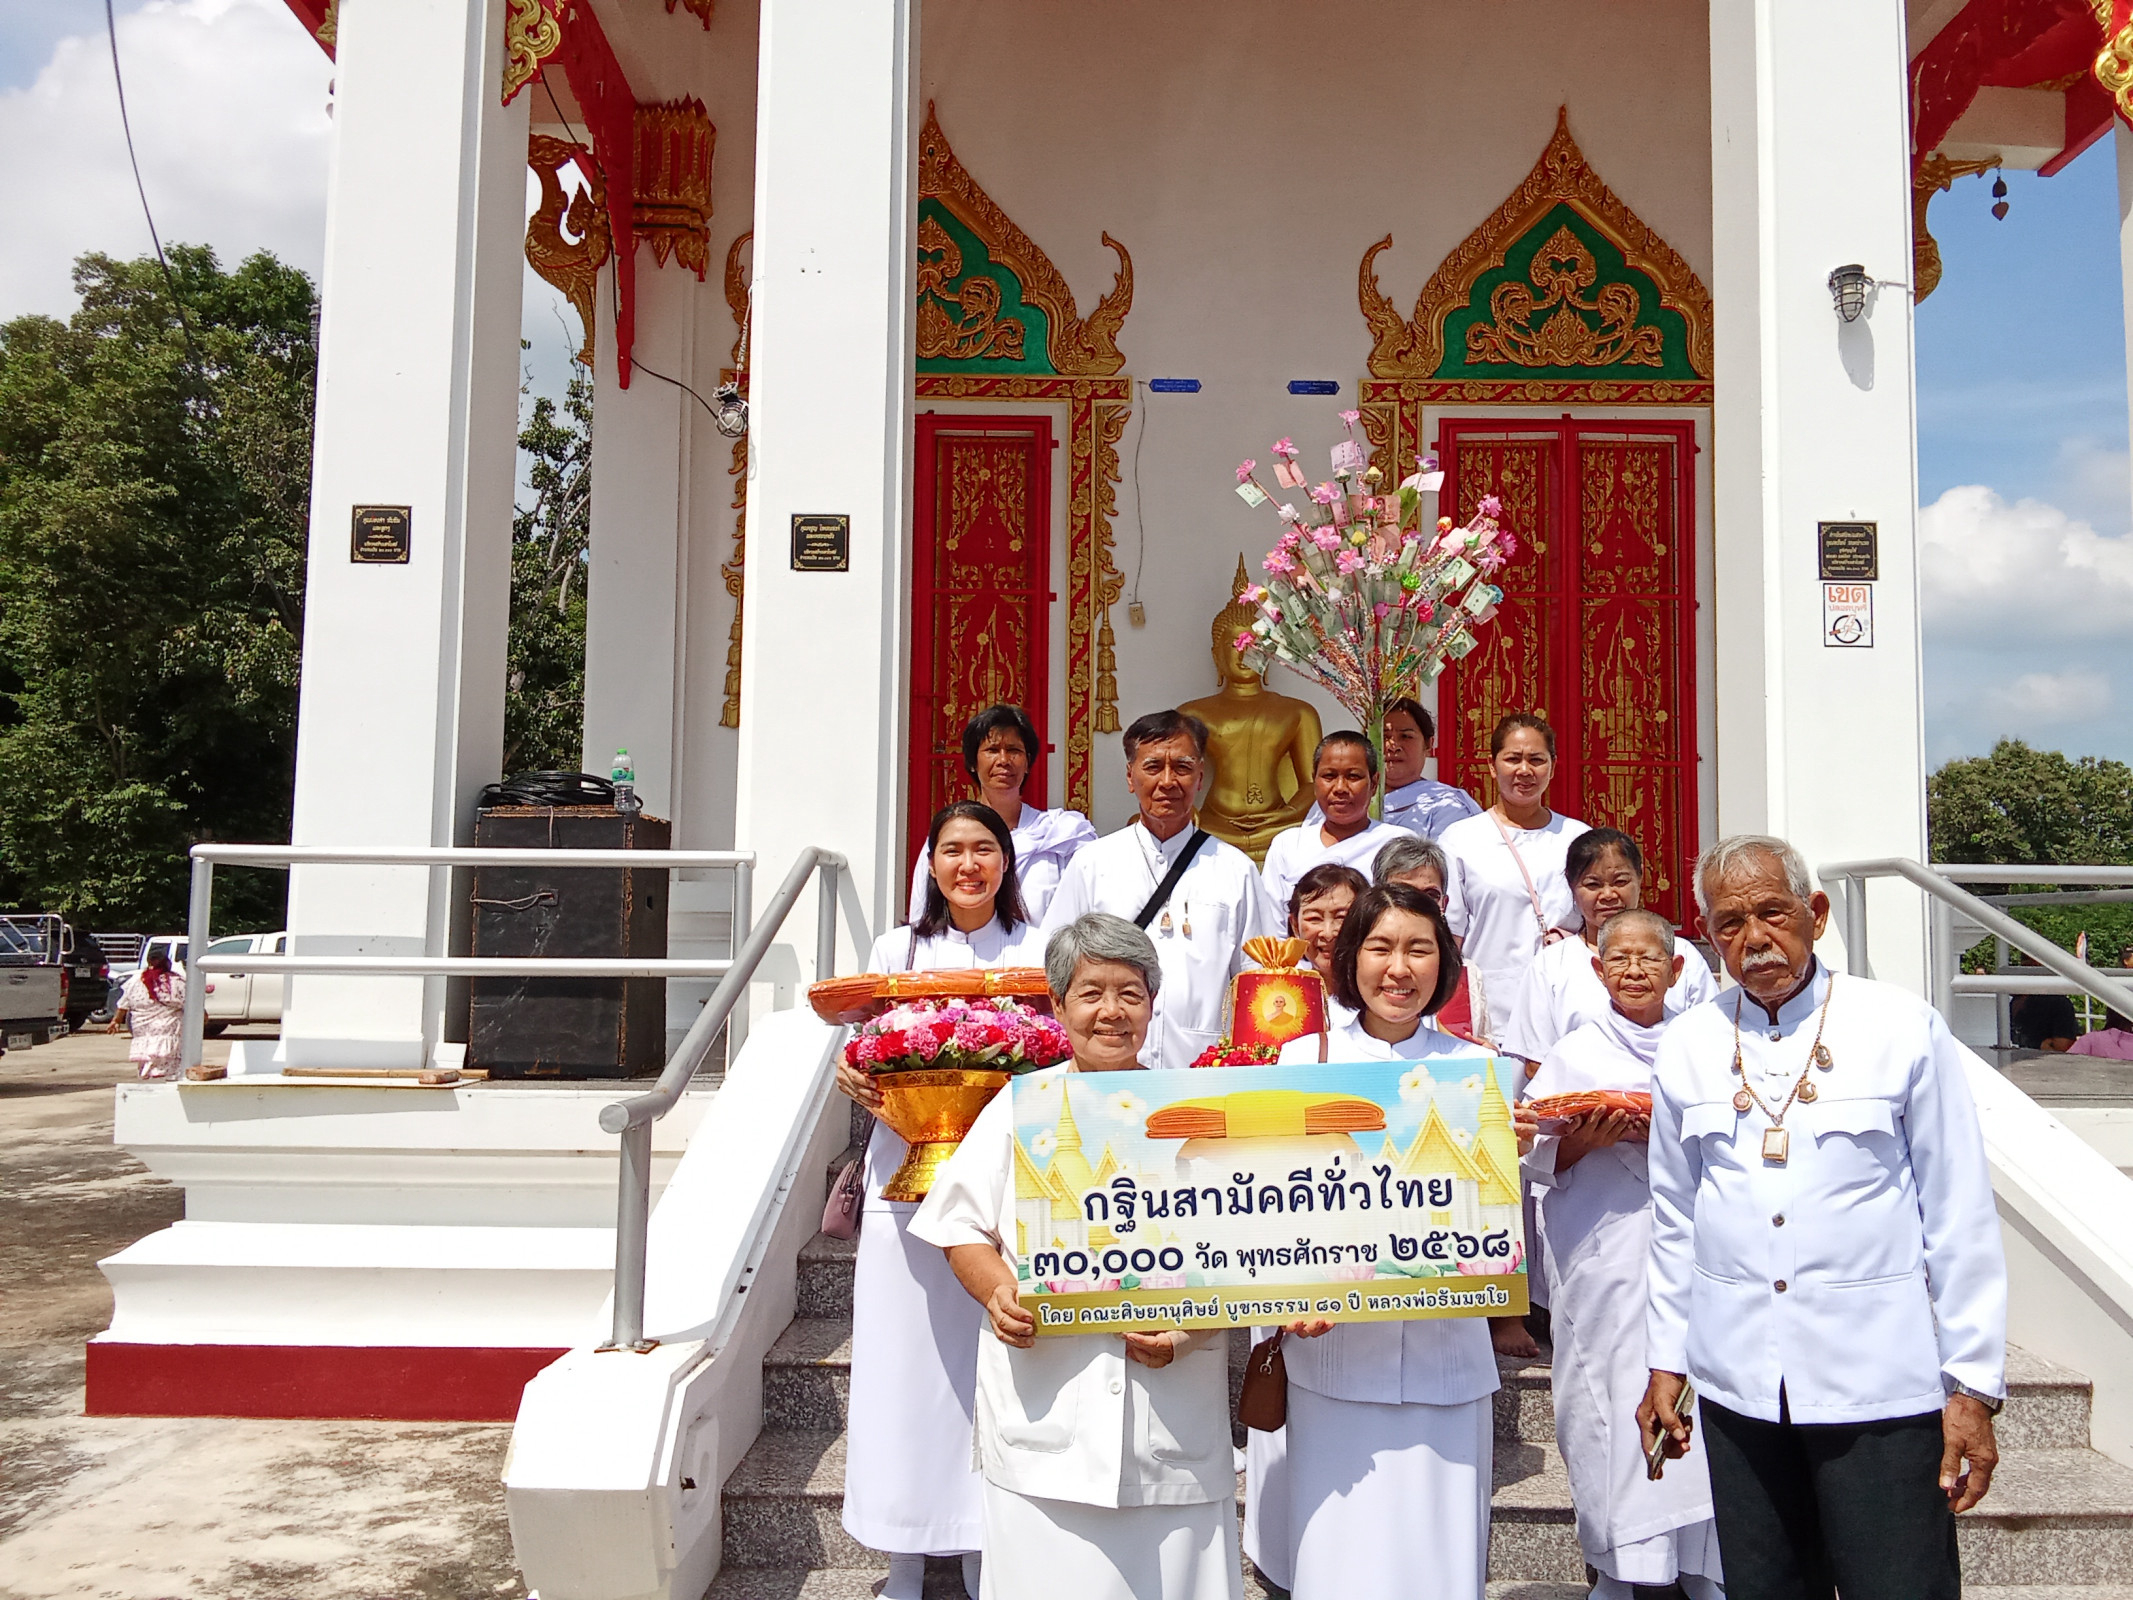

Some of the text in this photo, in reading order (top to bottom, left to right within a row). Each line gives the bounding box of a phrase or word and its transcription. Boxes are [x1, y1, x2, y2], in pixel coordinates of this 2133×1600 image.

[1829, 587, 1866, 603] เขต
[1084, 1156, 1453, 1233] กฐินสามัคคีทั่วไทย
[1034, 1229, 1510, 1280] ๓๐,๐๐๐ วัด พุทธศักราช ๒๕๖๘
[1041, 1305, 1073, 1323] โดย
[1081, 1298, 1219, 1323] คณะศิษยานุศิษย์
[1226, 1299, 1309, 1321] บูชาธรรม
[1316, 1300, 1341, 1312] ๘๑
[1347, 1292, 1361, 1310] ปี
